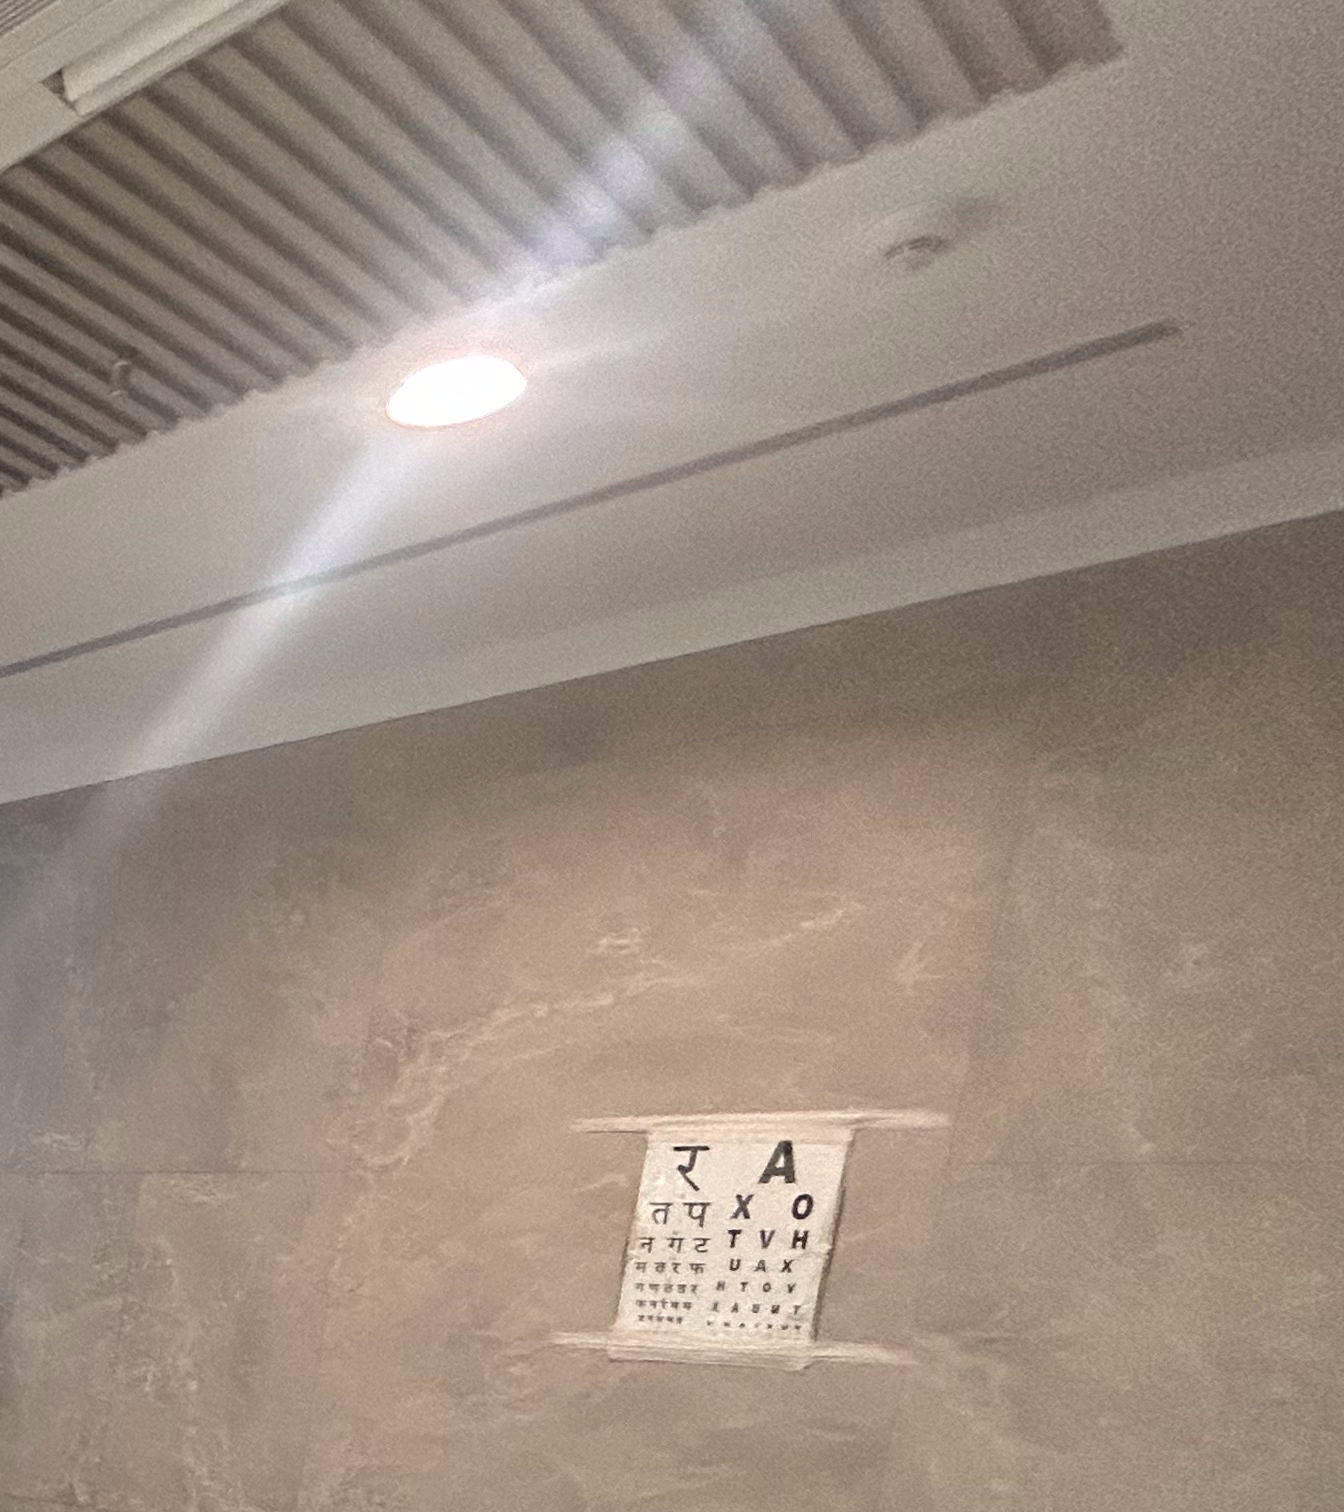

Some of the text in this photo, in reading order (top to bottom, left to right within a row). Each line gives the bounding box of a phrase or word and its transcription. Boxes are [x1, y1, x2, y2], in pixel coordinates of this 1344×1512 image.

[672, 1145, 711, 1192] र
[757, 1139, 797, 1185] A
[648, 1201, 712, 1229] त प
[729, 1193, 815, 1221] X O
[638, 1236, 712, 1254] न ग ट
[727, 1228, 810, 1250] T V H
[728, 1258, 794, 1274] U A X
[740, 1280, 750, 1293] T
